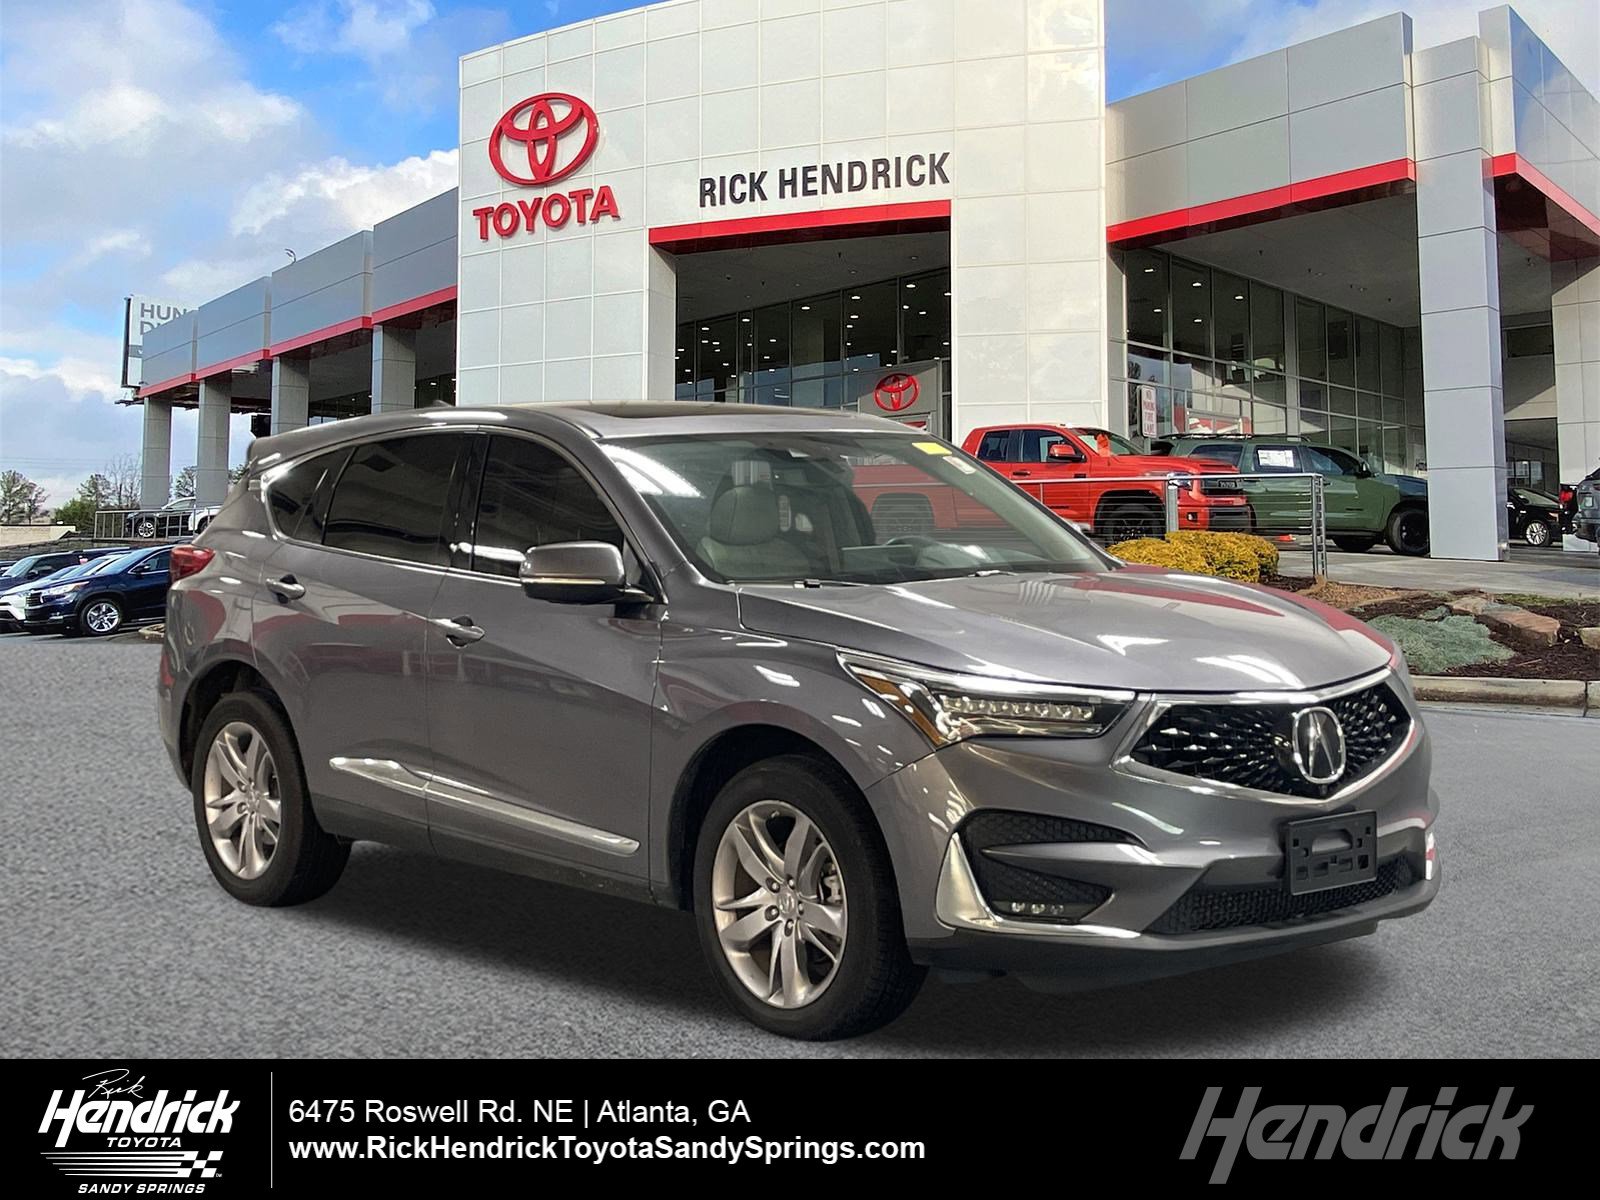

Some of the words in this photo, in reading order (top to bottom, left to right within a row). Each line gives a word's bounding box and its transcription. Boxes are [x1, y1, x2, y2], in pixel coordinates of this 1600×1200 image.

[699, 170, 768, 208] RICK
[778, 152, 951, 200] HENDRICK
[473, 184, 620, 240] TOYOTA
